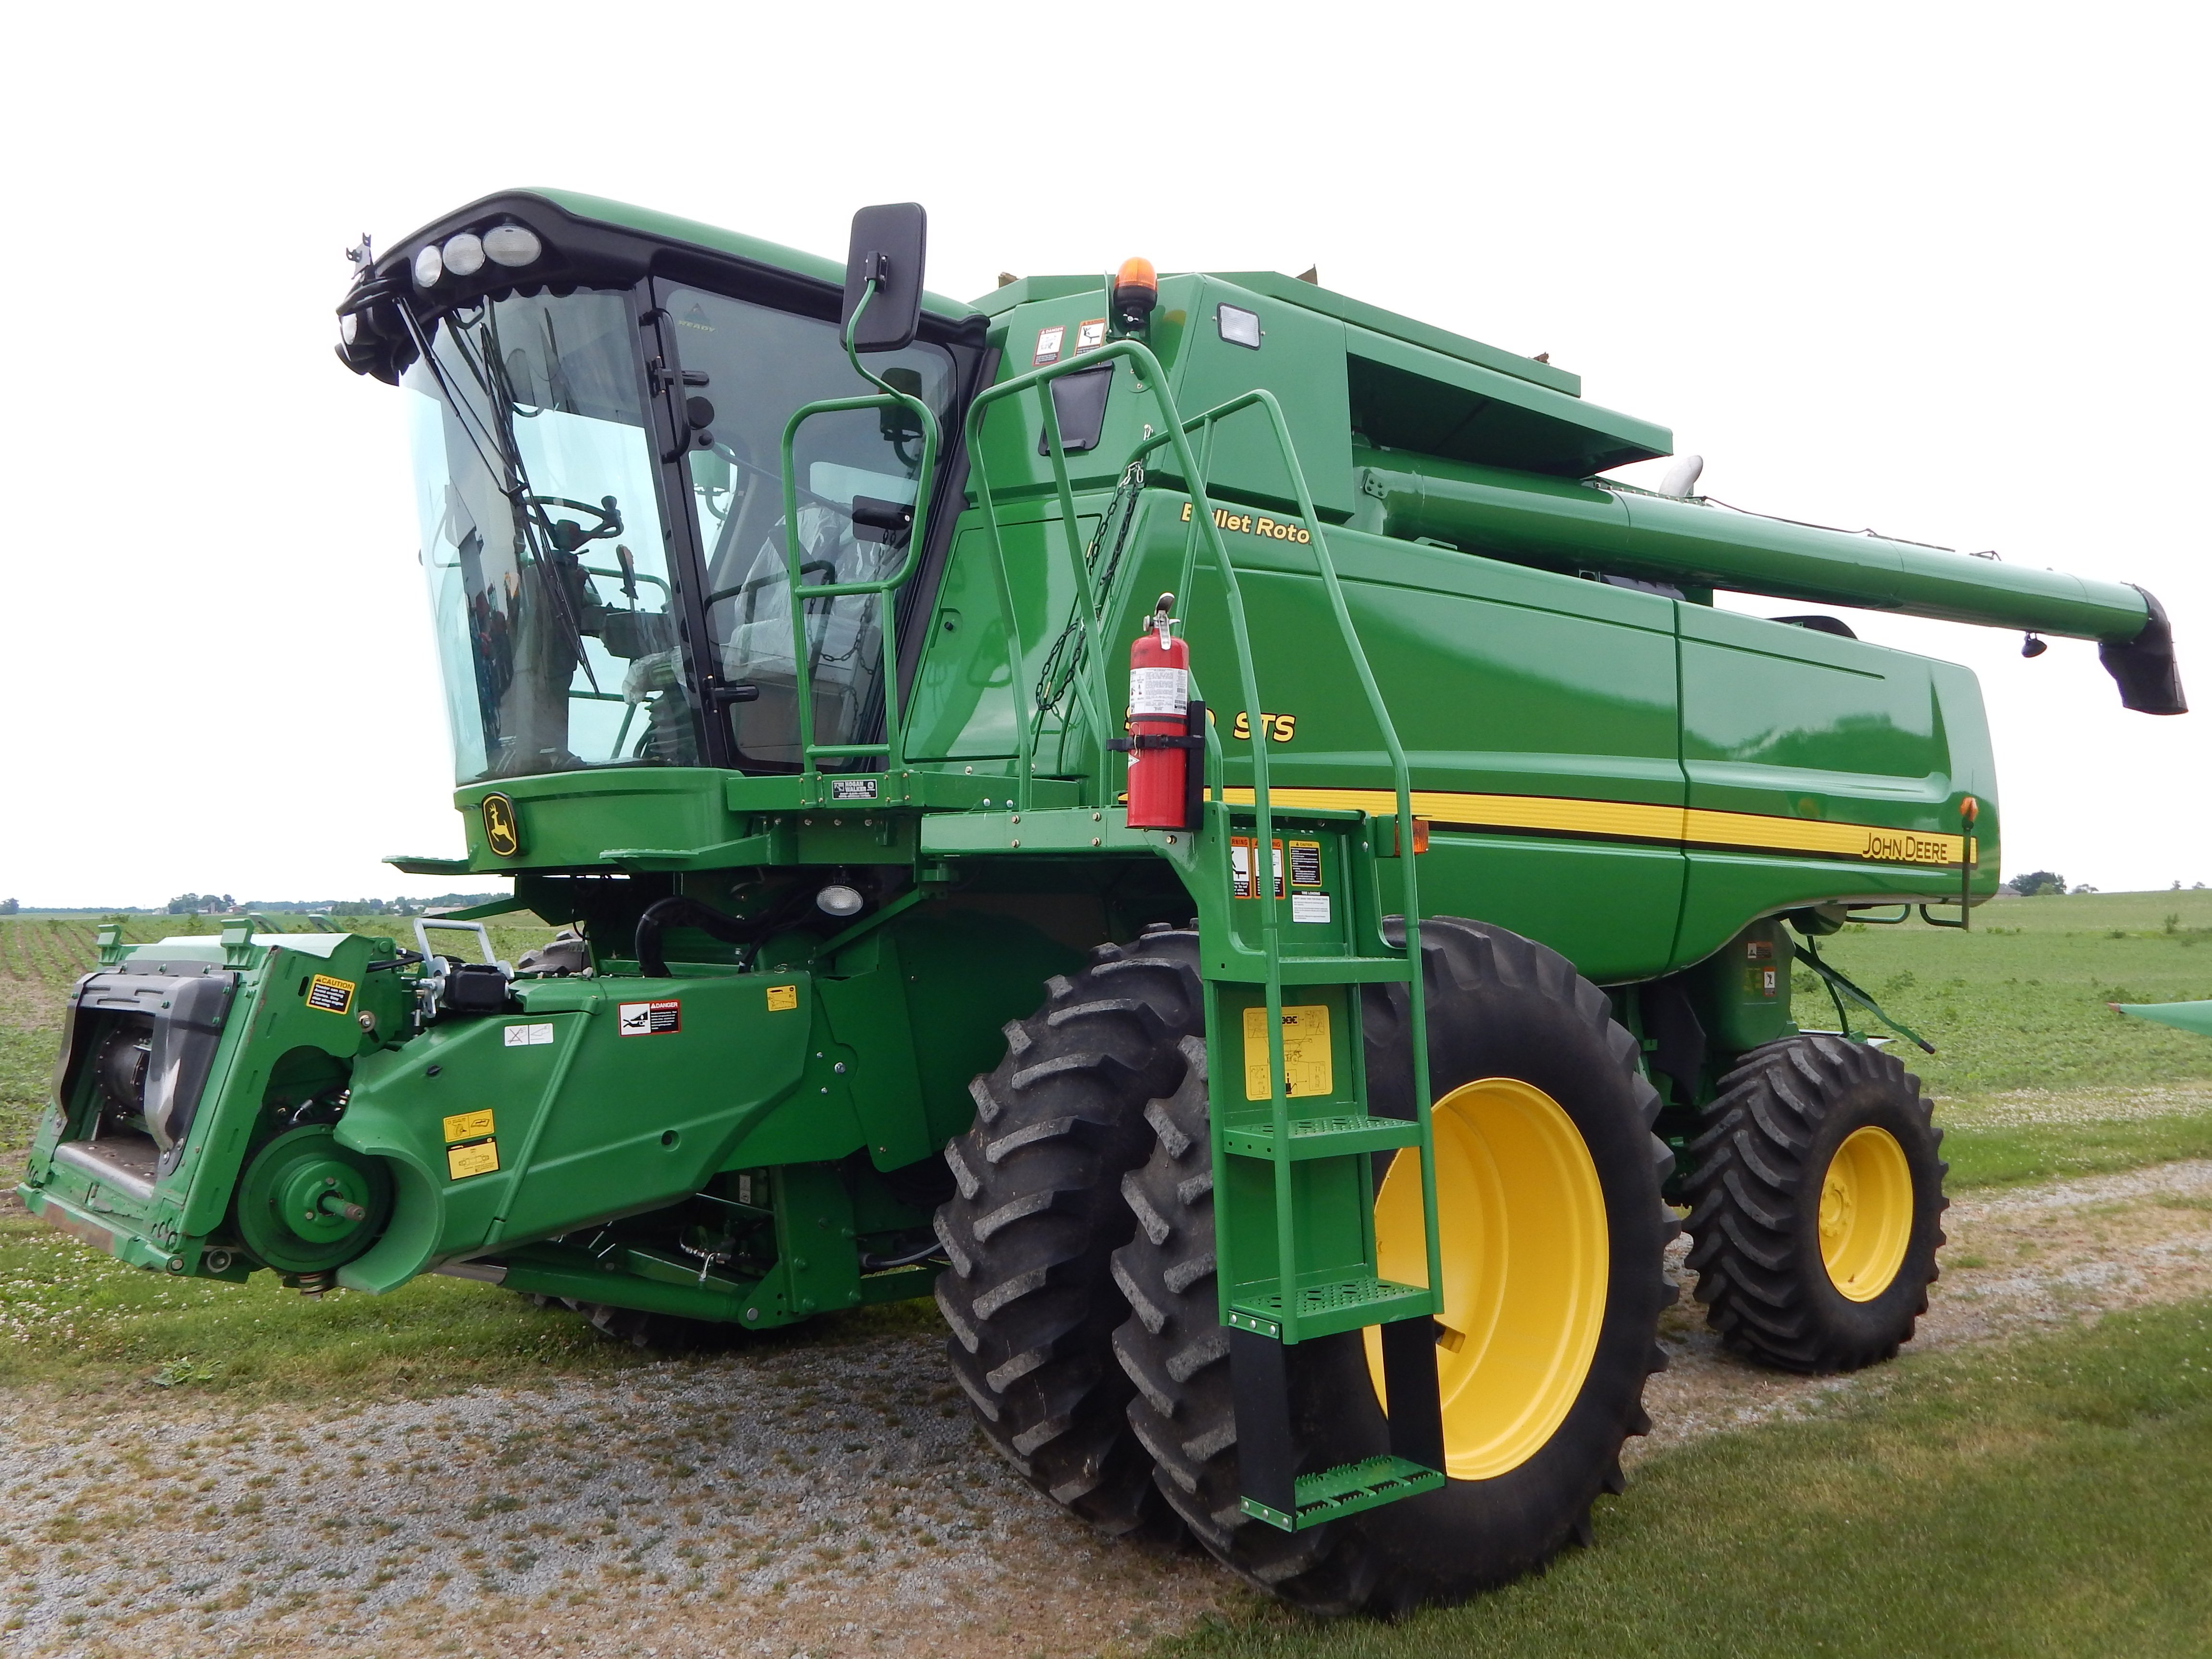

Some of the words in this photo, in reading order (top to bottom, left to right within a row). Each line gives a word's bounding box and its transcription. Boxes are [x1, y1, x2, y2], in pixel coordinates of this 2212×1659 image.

[1180, 502, 1252, 534] Bllet
[1255, 516, 1312, 545] Roto
[1862, 832, 1902, 857] JOHN
[1905, 836, 1948, 861] DEERE
[322, 977, 353, 990] CAUTION
